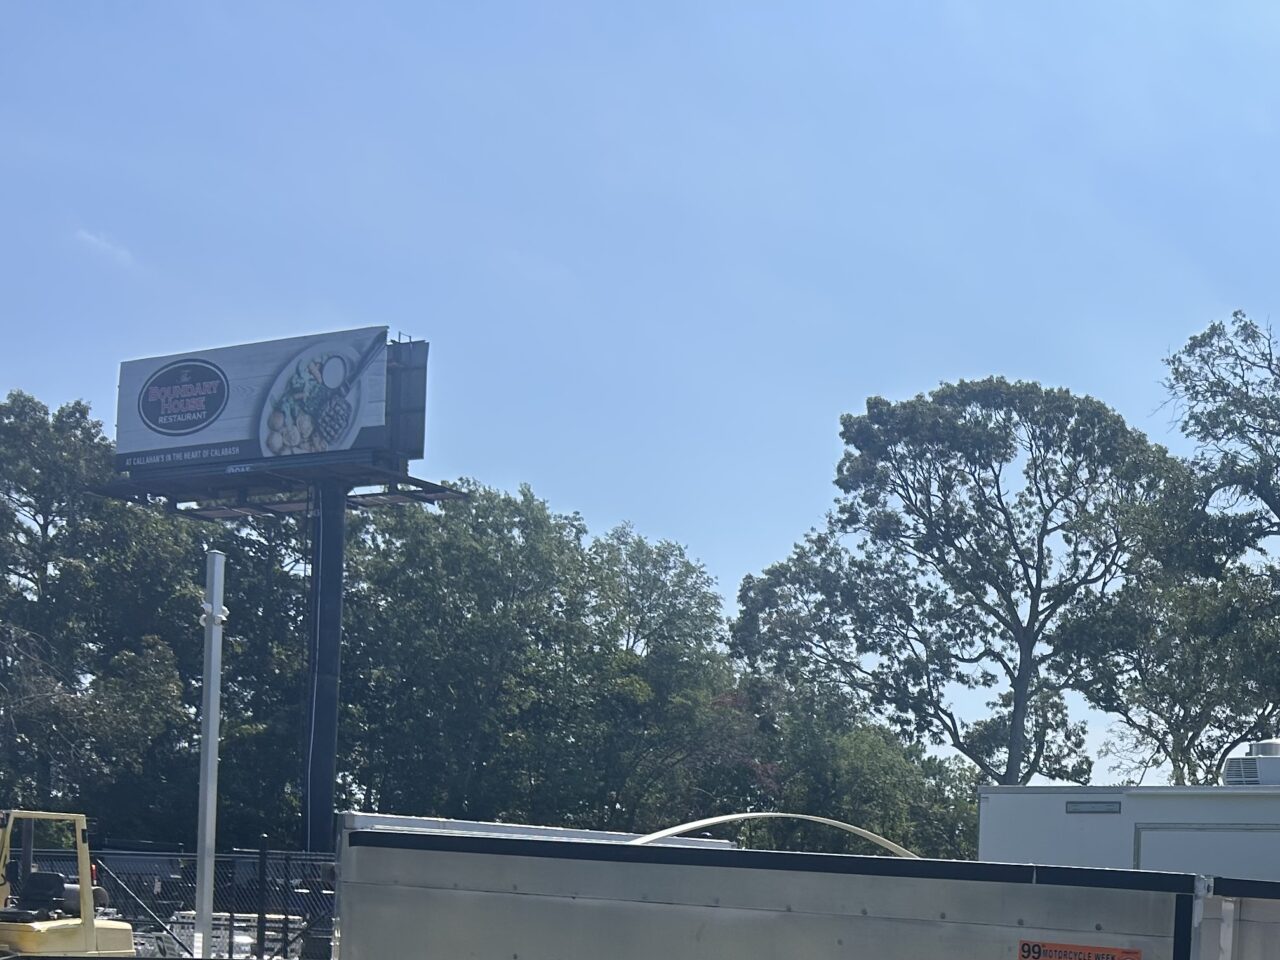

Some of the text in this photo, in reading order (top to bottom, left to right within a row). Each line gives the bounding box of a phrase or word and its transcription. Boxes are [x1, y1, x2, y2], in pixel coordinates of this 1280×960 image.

[148, 380, 220, 402] BOUNDARY
[160, 396, 206, 414] HOUSE
[158, 411, 207, 424] RESTAURANT
[172, 452, 183, 461] THE
[183, 450, 201, 460] HEART
[202, 449, 209, 458] OF
[210, 446, 240, 457] CALABASH
